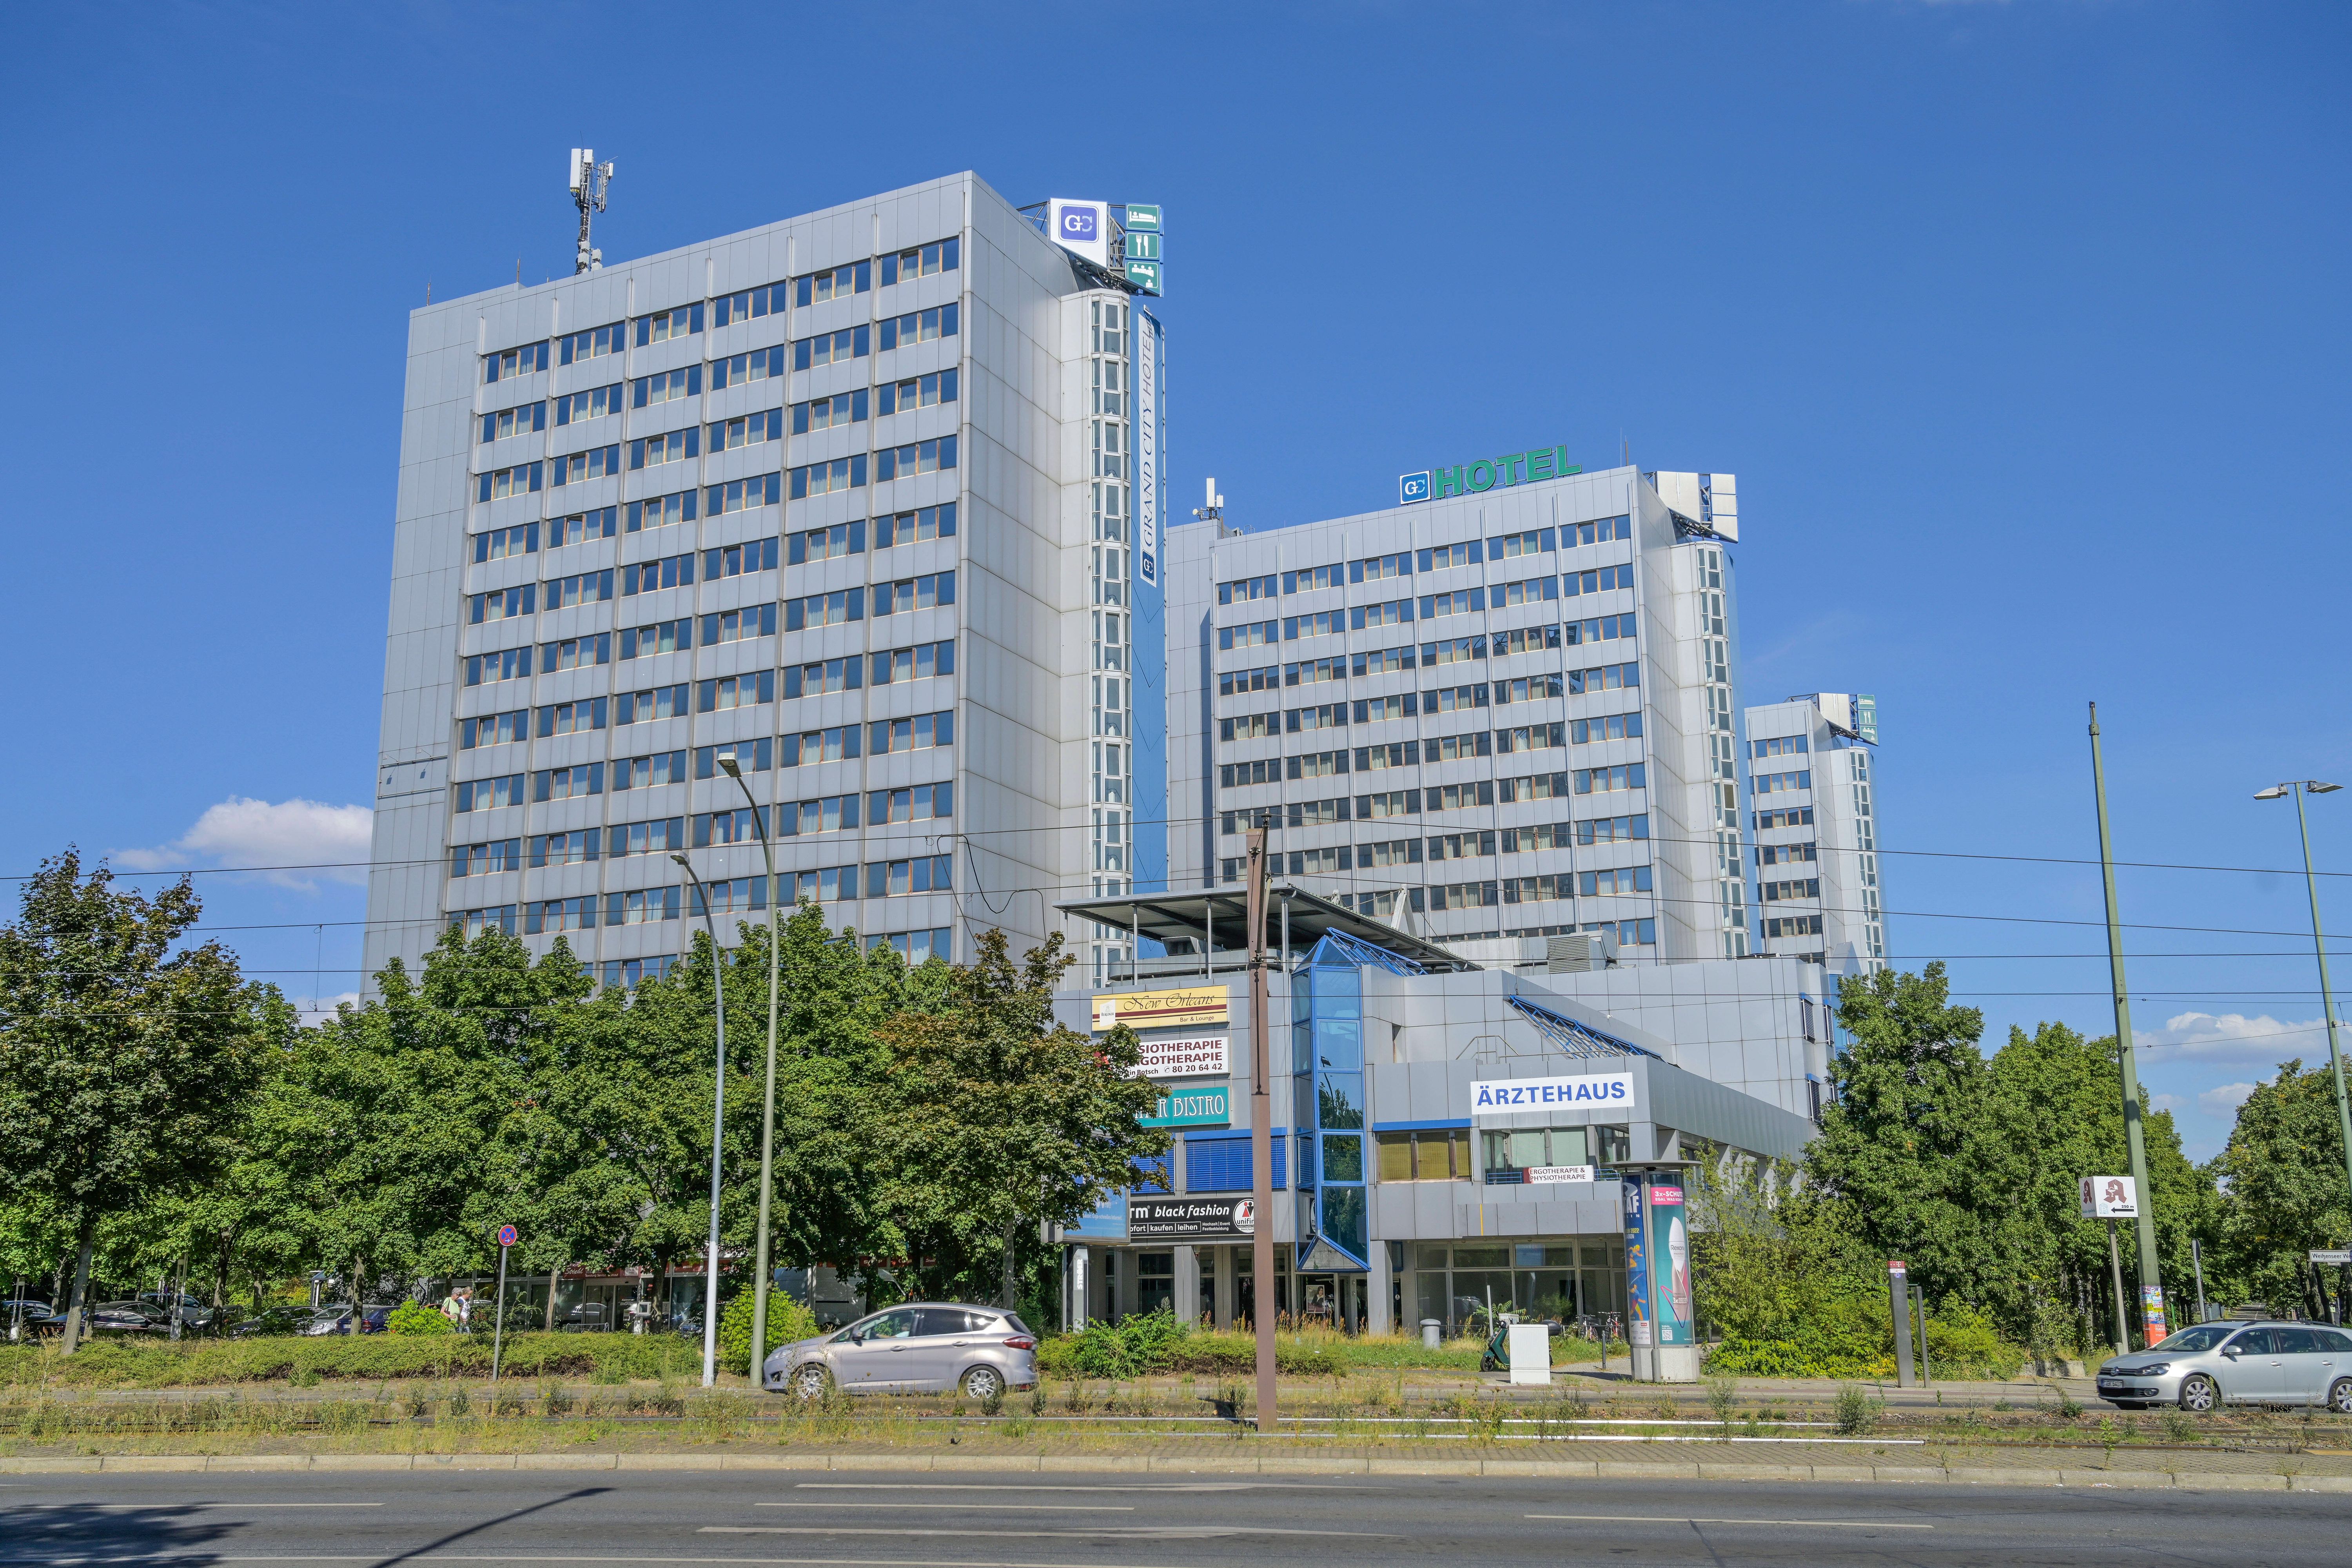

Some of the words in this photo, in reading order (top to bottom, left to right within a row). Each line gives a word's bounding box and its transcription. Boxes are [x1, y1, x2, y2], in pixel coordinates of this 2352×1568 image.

[1142, 330, 1151, 397] HOTEL
[1143, 397, 1152, 456] CITY
[1434, 444, 1582, 499] HOTEL
[1143, 461, 1152, 547] GRAND
[1123, 995, 1161, 1011] New
[1166, 992, 1215, 1008] Orleans
[1138, 1040, 1222, 1054] SIOTHERAPIE
[1136, 1052, 1223, 1066] GOTHERAPIE
[1477, 1081, 1626, 1106] ÄRZTEHAUS
[1173, 1095, 1224, 1117] BISTRO
[1155, 1205, 1185, 1217] black
[1187, 1204, 1229, 1218] fashion
